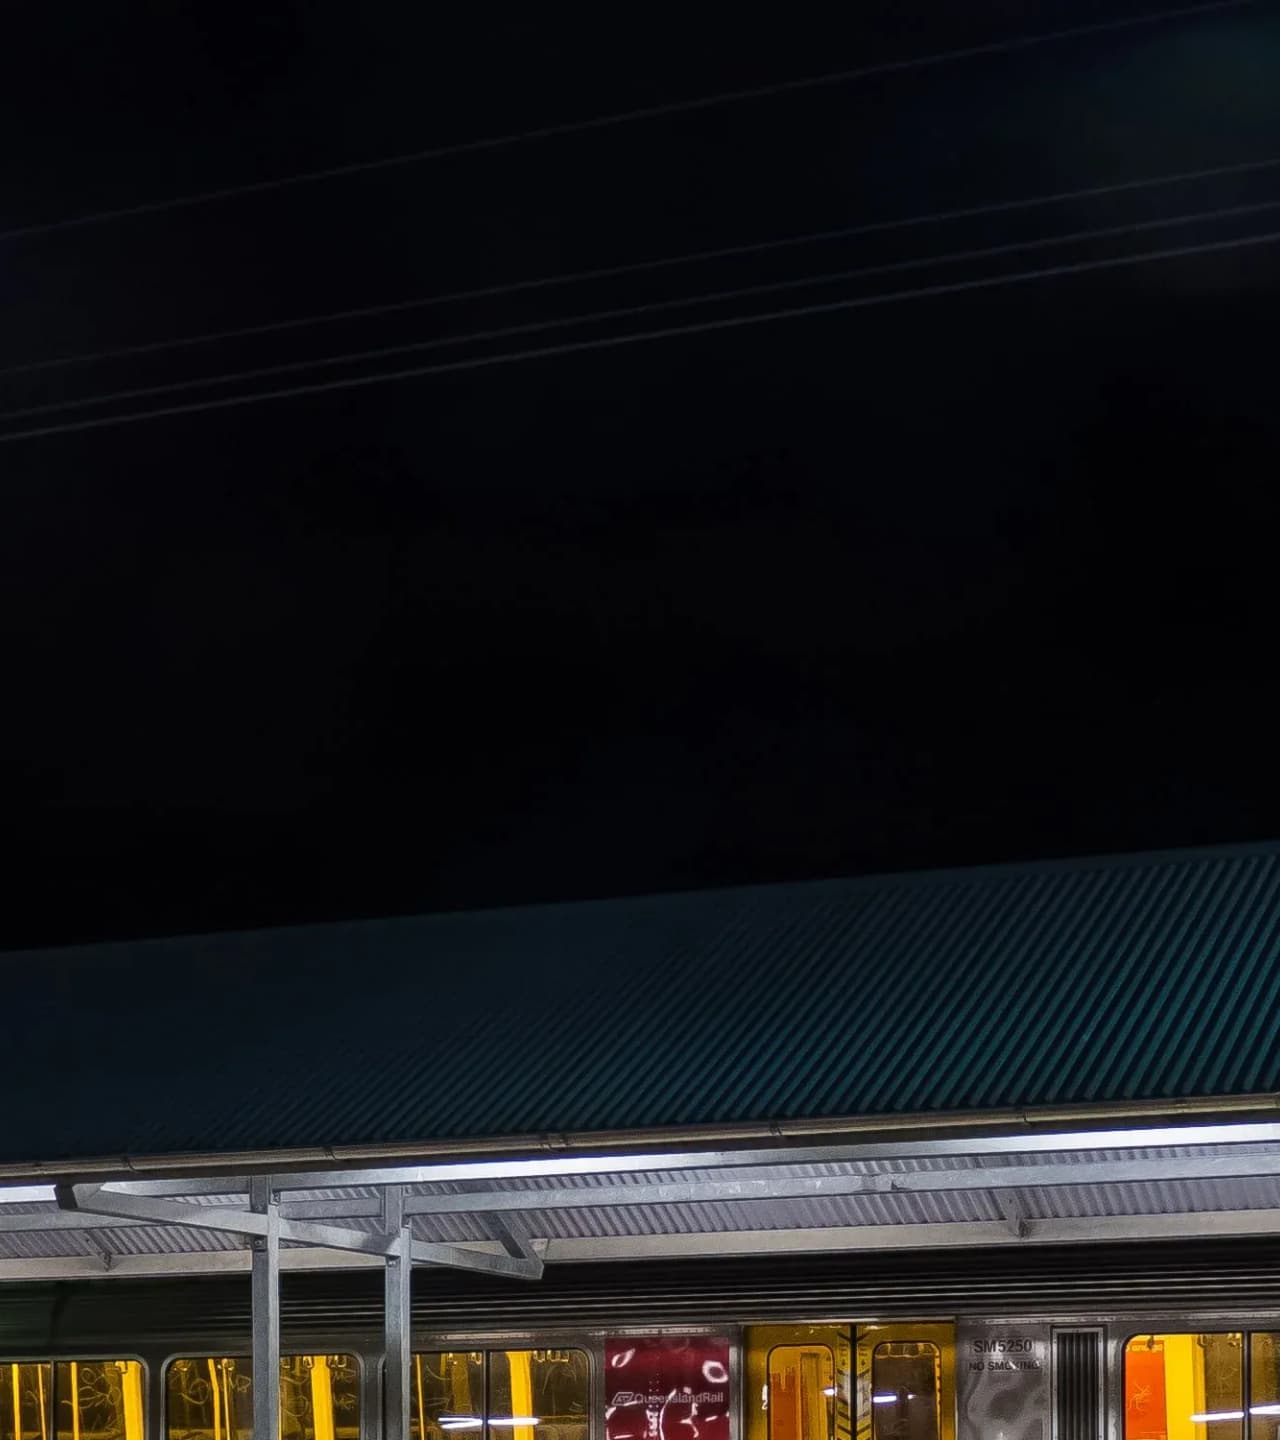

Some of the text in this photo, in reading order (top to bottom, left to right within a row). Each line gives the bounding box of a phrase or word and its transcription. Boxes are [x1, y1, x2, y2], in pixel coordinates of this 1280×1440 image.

[974, 1339, 1033, 1353] SM5250
[968, 1360, 1041, 1372] NO SMOKING
